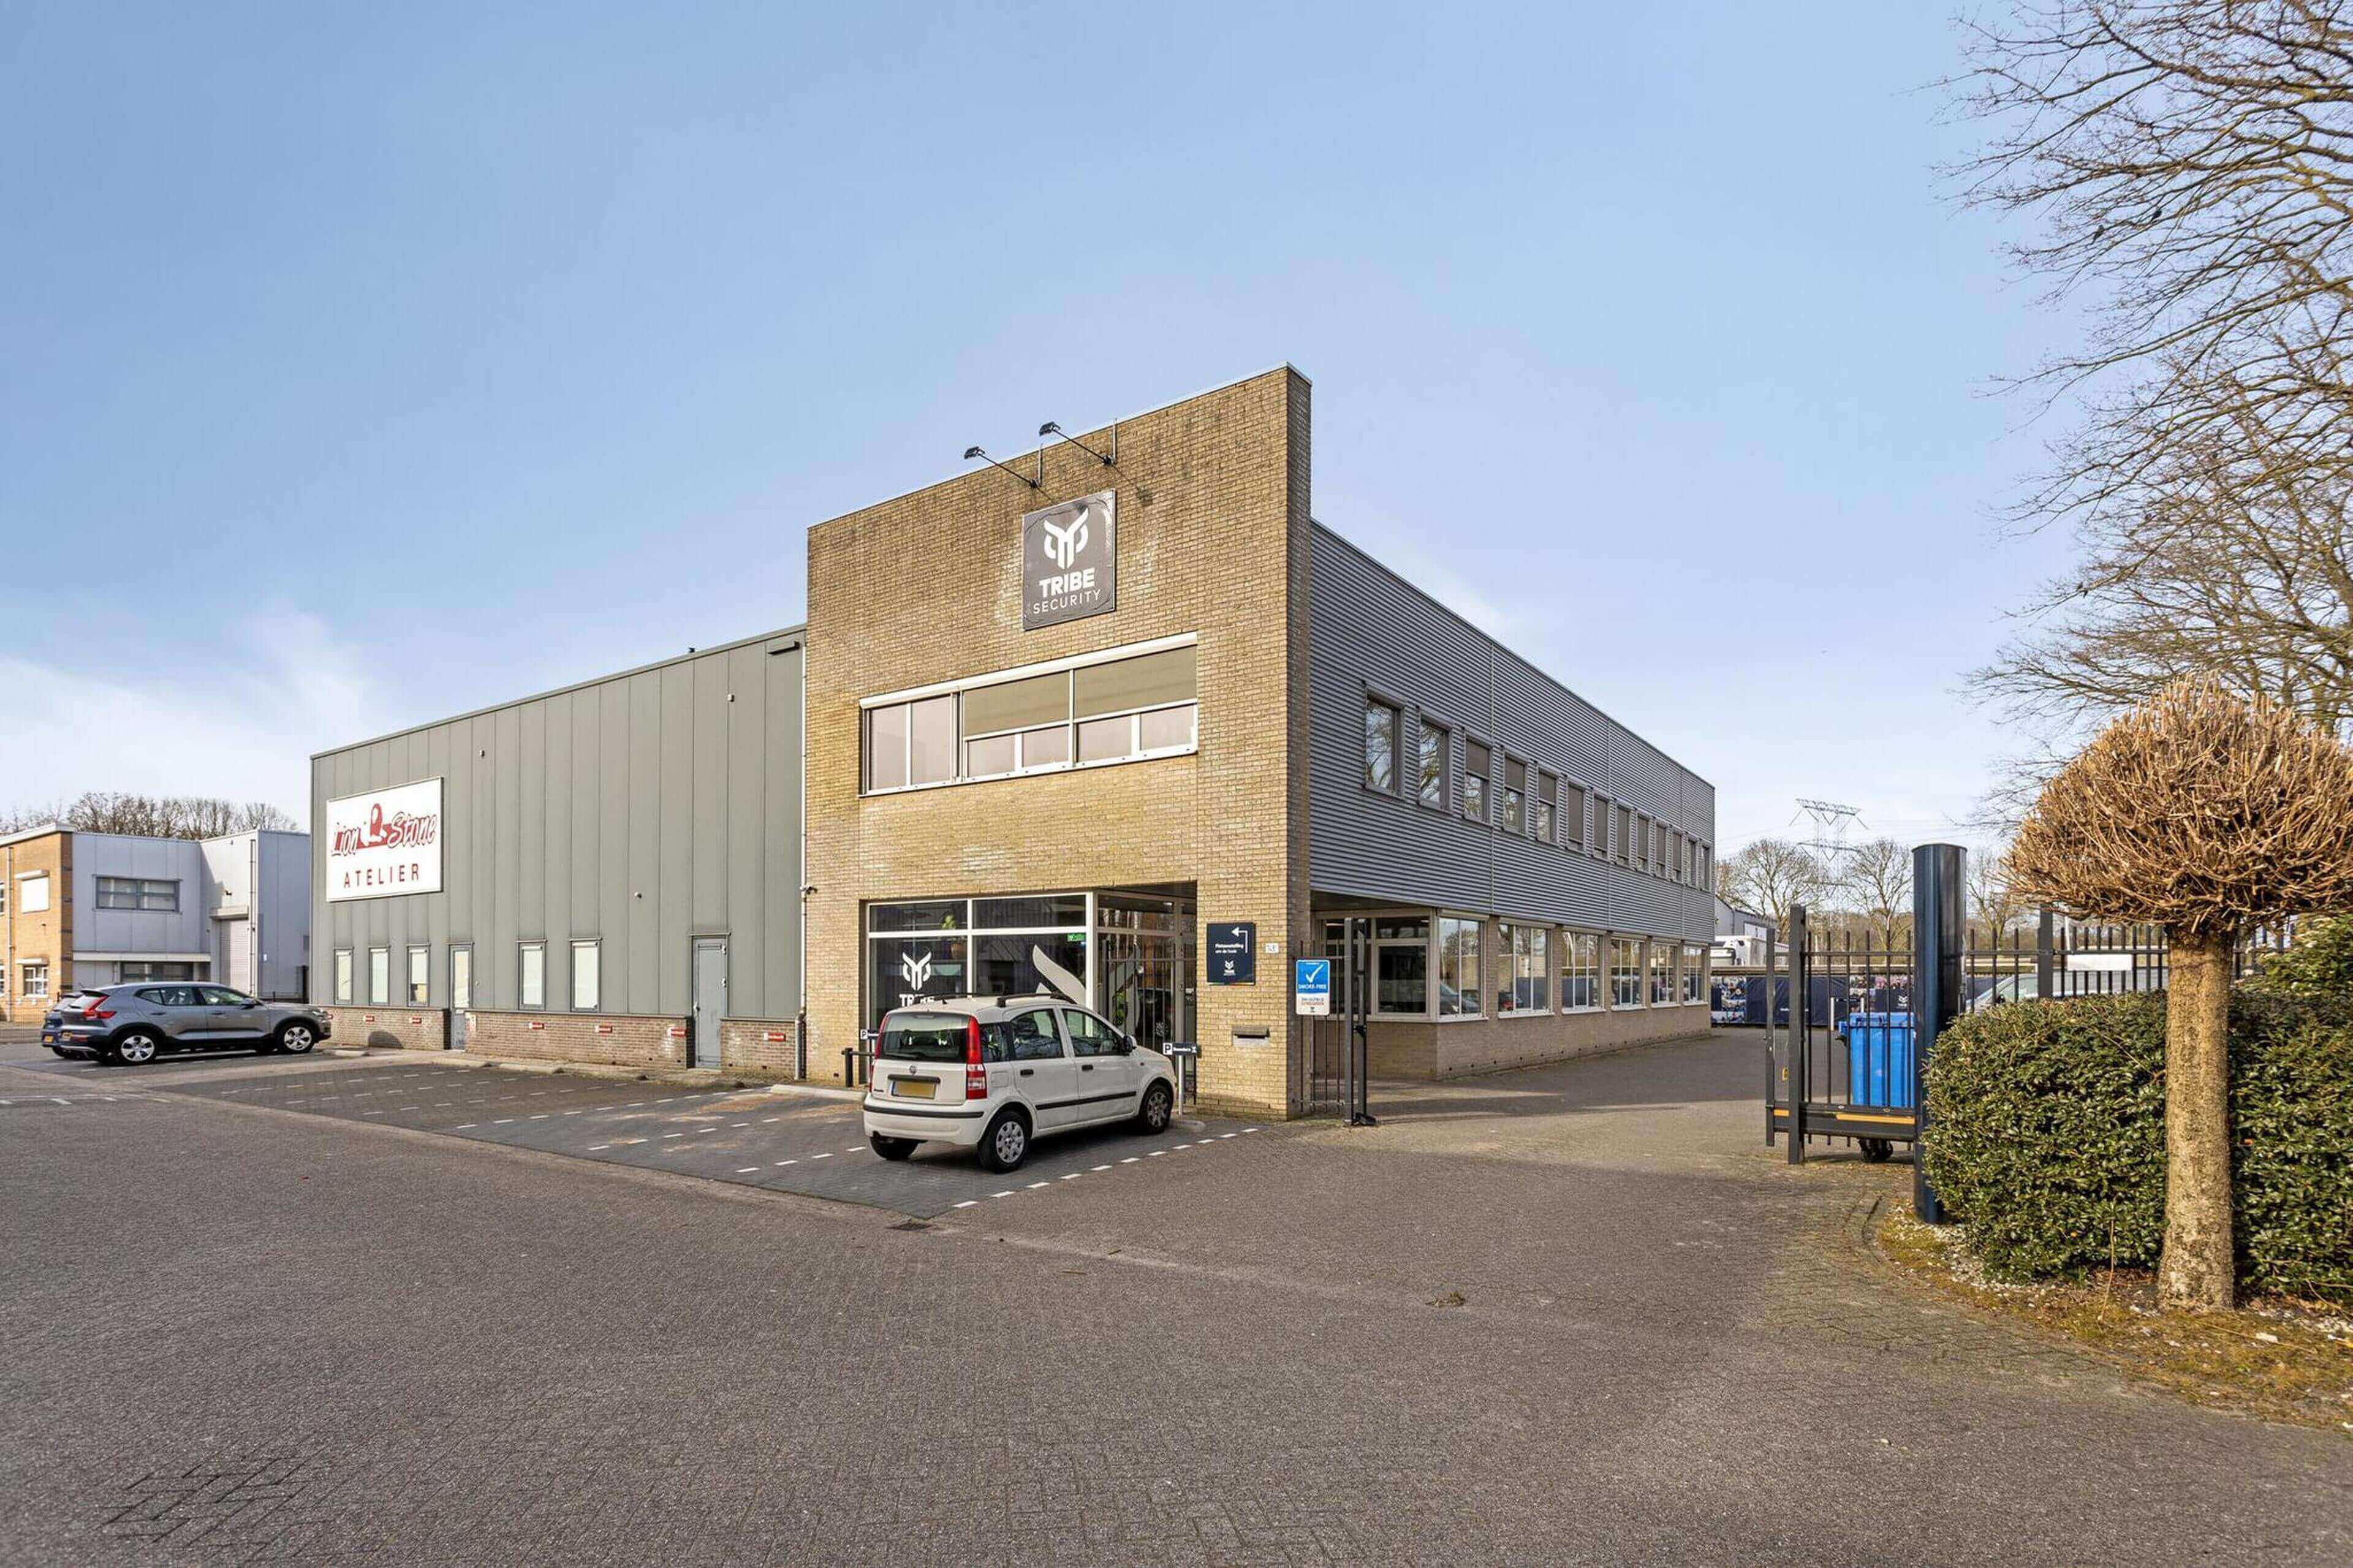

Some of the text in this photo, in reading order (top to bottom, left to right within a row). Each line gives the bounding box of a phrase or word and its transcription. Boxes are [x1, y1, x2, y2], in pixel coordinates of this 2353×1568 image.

[1039, 567, 1096, 598] TRIBE
[1033, 589, 1101, 614] SECURITY
[386, 811, 438, 849] Stone
[343, 863, 420, 888] ATELIER
[1164, 1043, 1171, 1053] P
